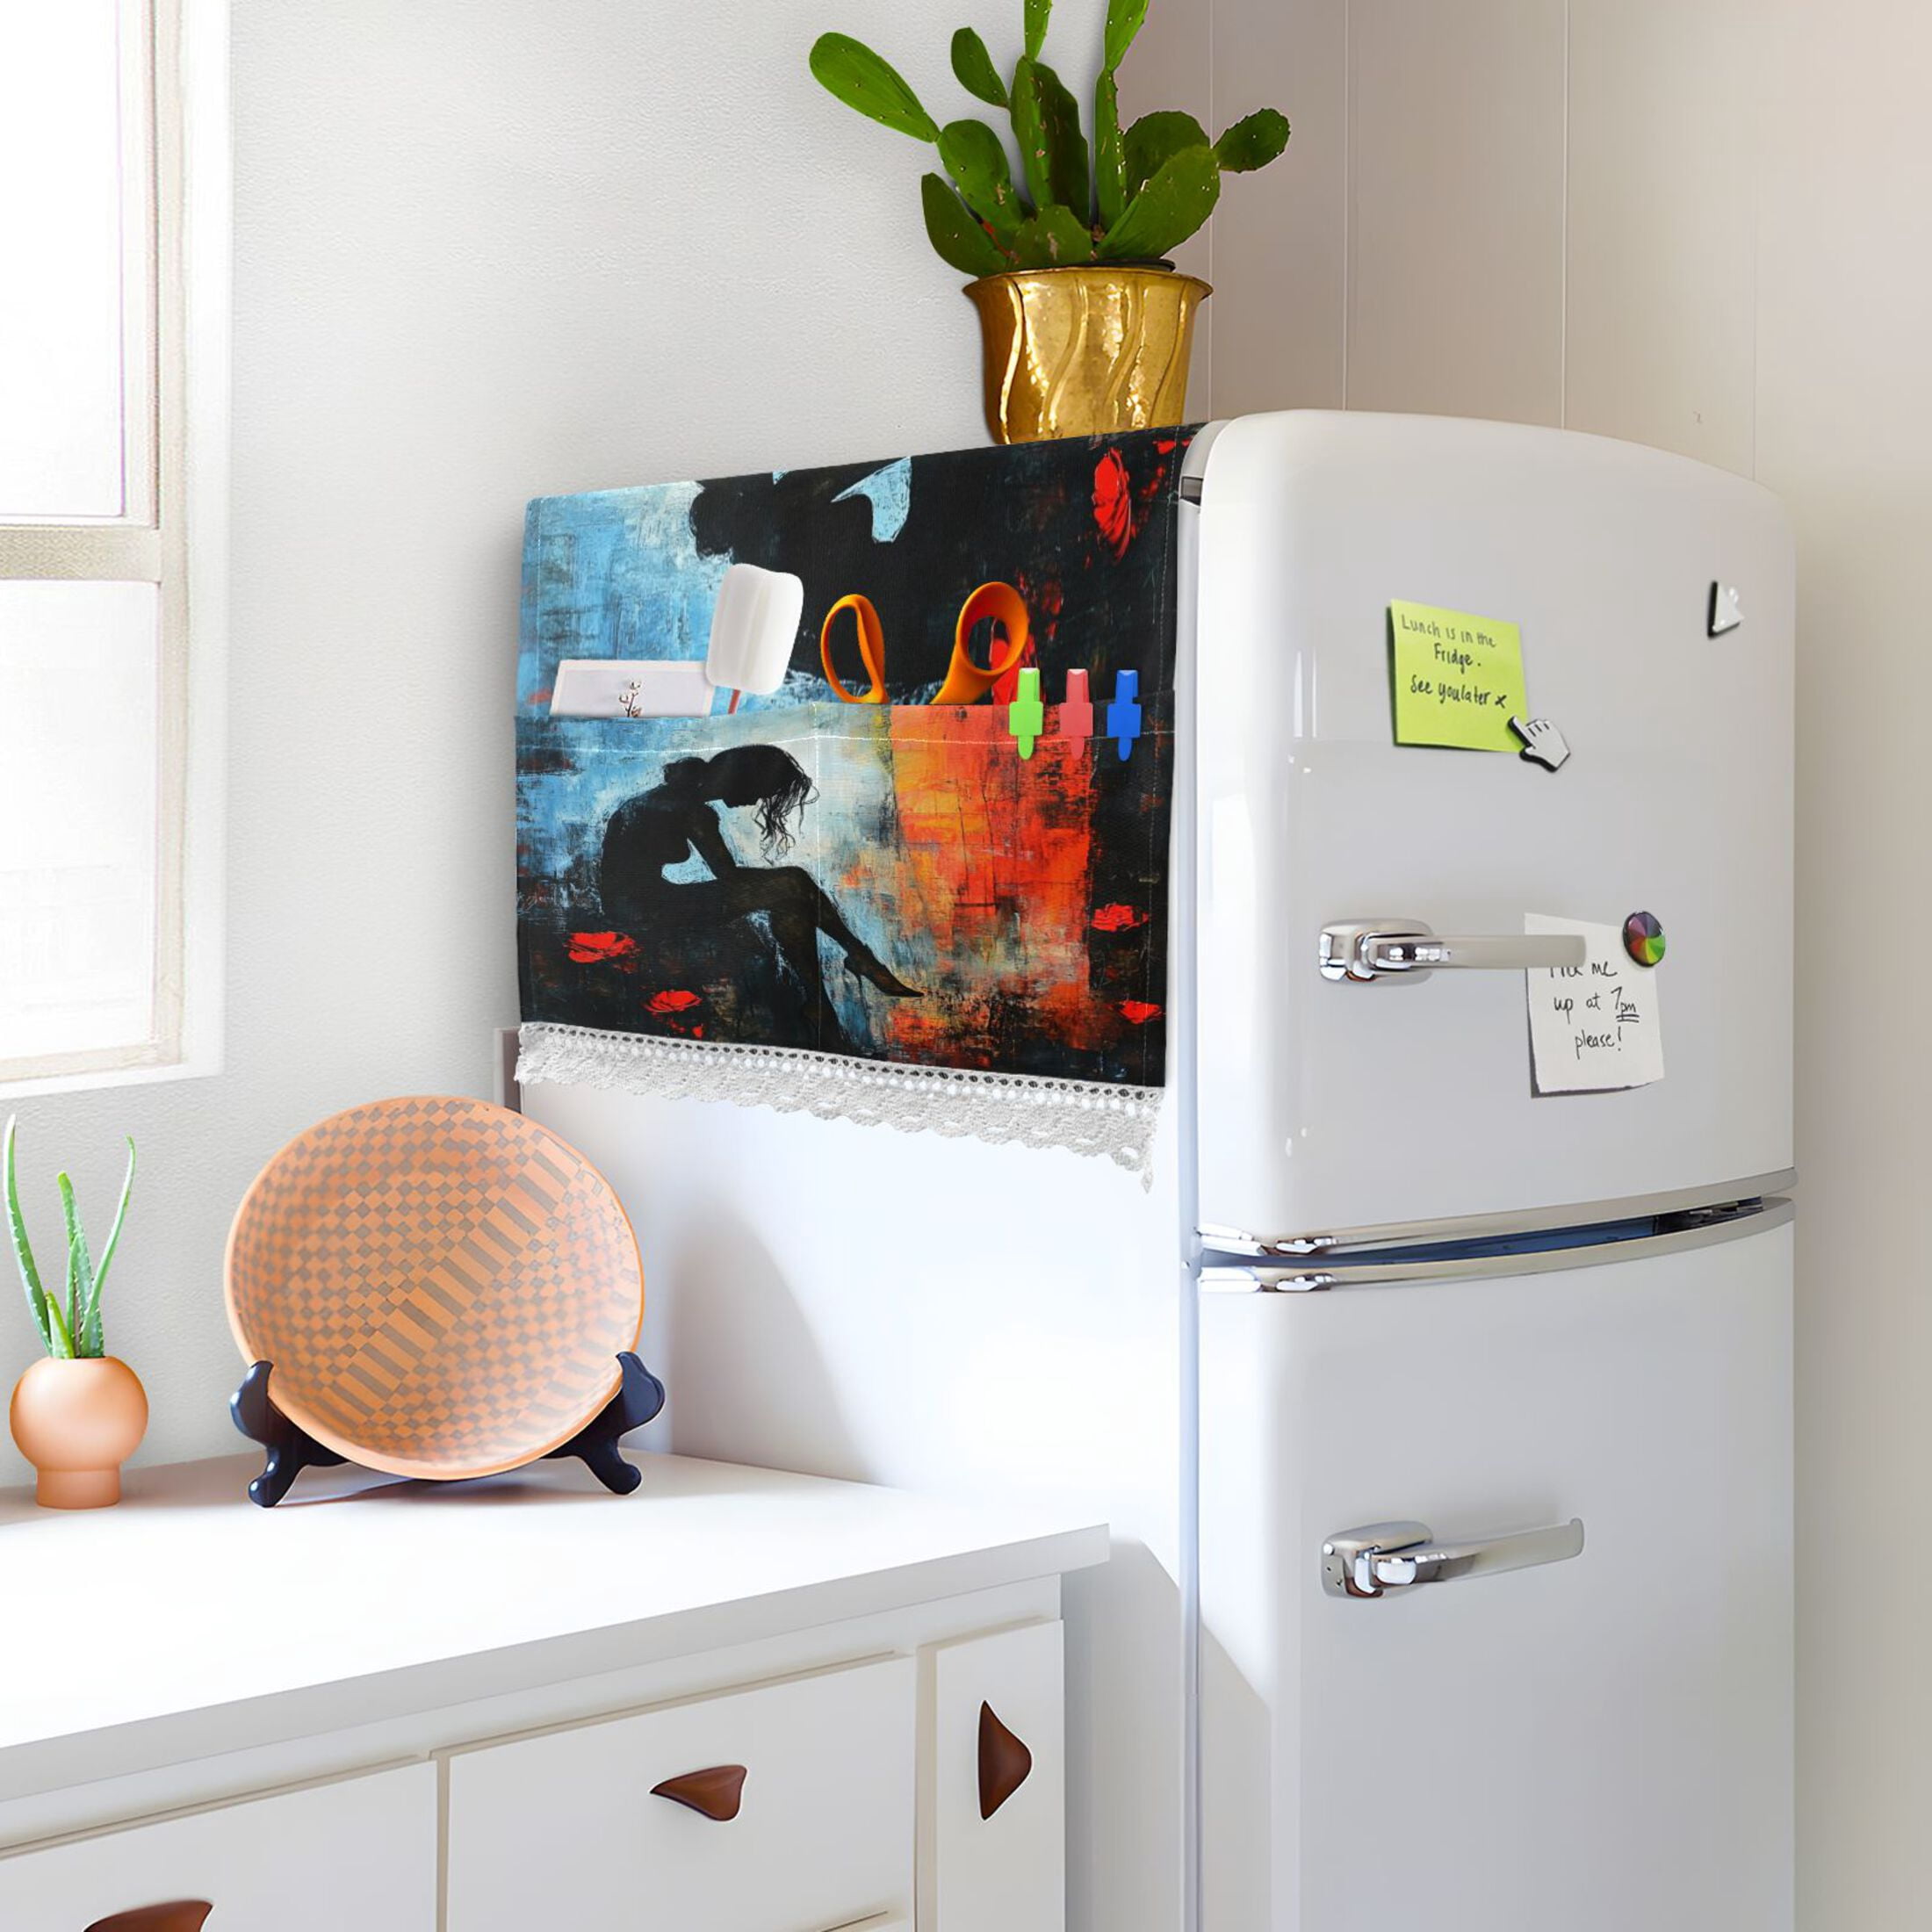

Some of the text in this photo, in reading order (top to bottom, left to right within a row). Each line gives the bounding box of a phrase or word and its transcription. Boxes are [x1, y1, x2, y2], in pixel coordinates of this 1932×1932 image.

[1401, 614, 1441, 638] Lunch
[1477, 631, 1496, 648] the
[1410, 674, 1433, 694] See
[1554, 986, 1639, 1024] up at 7pm
[1575, 1026, 1622, 1060] please!
